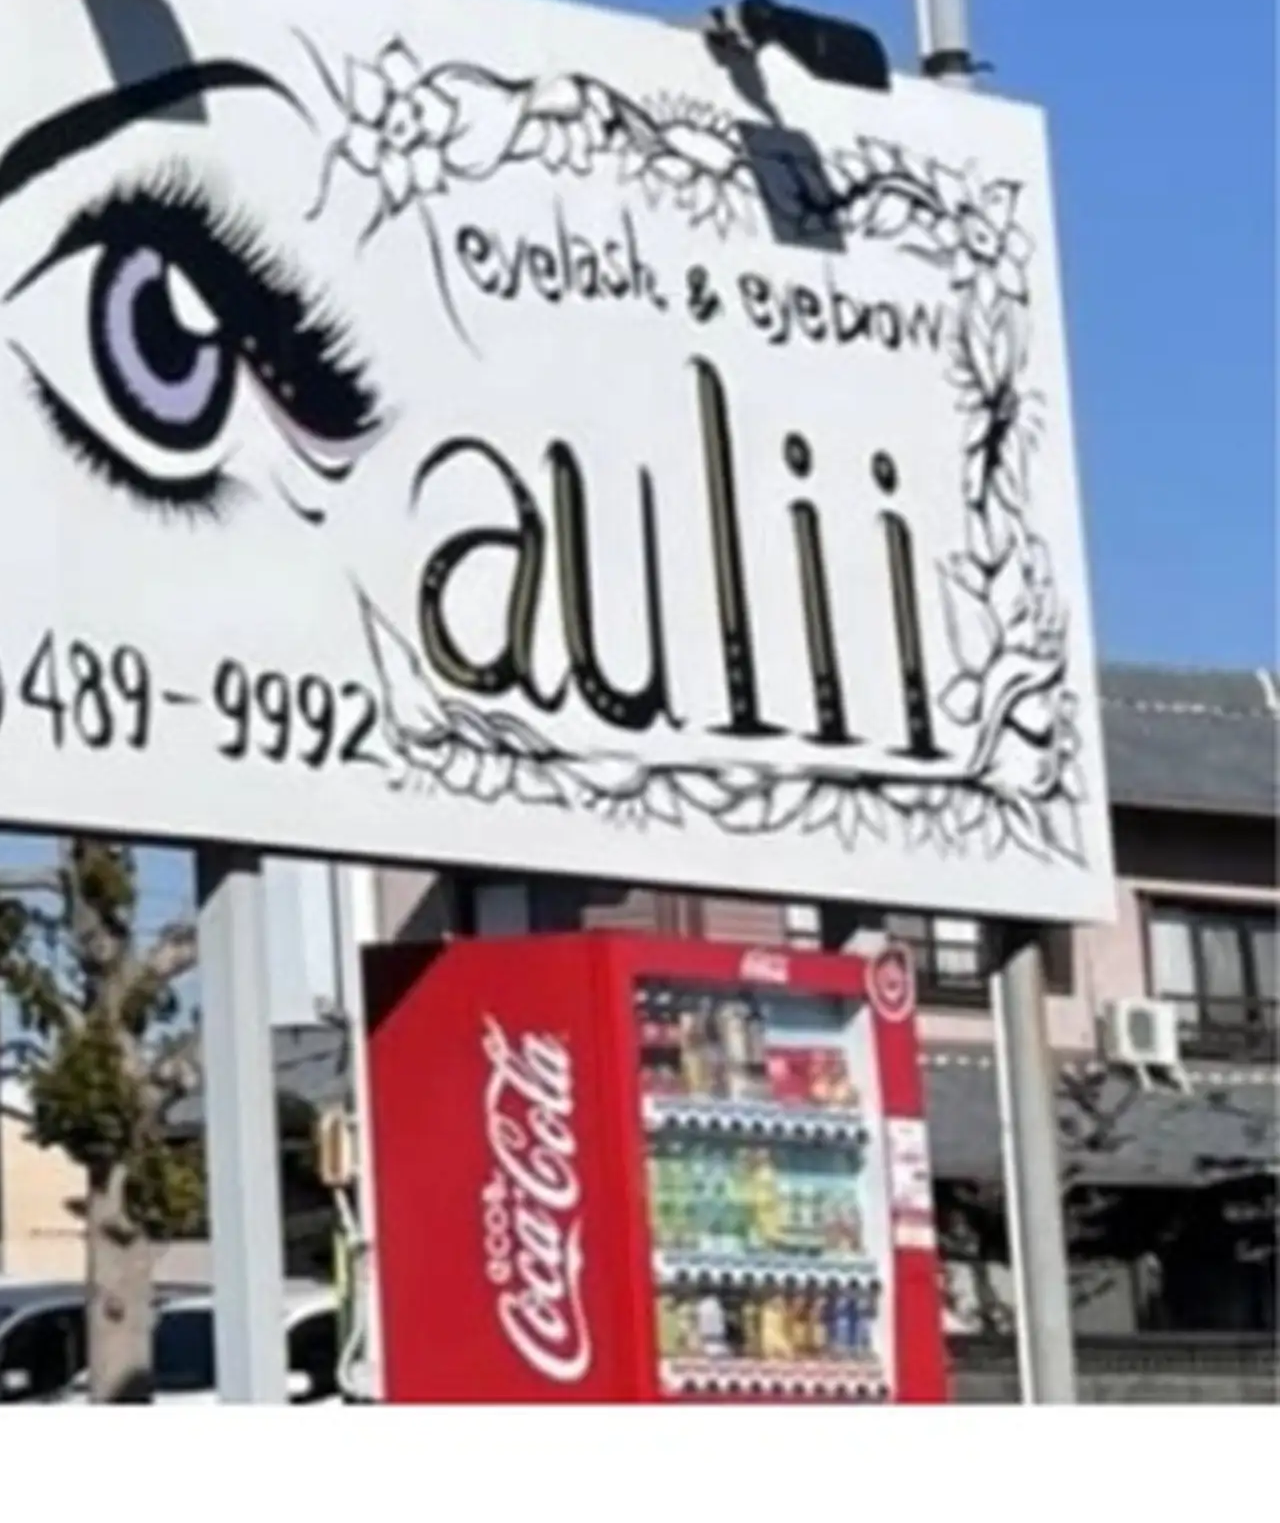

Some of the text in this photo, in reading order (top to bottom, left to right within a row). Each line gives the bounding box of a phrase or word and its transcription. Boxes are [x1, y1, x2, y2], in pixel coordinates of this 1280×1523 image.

[455, 193, 944, 350] eyelash & eyebrow
[411, 353, 952, 759] aulii
[482, 1011, 591, 1382] Coca-Cola
